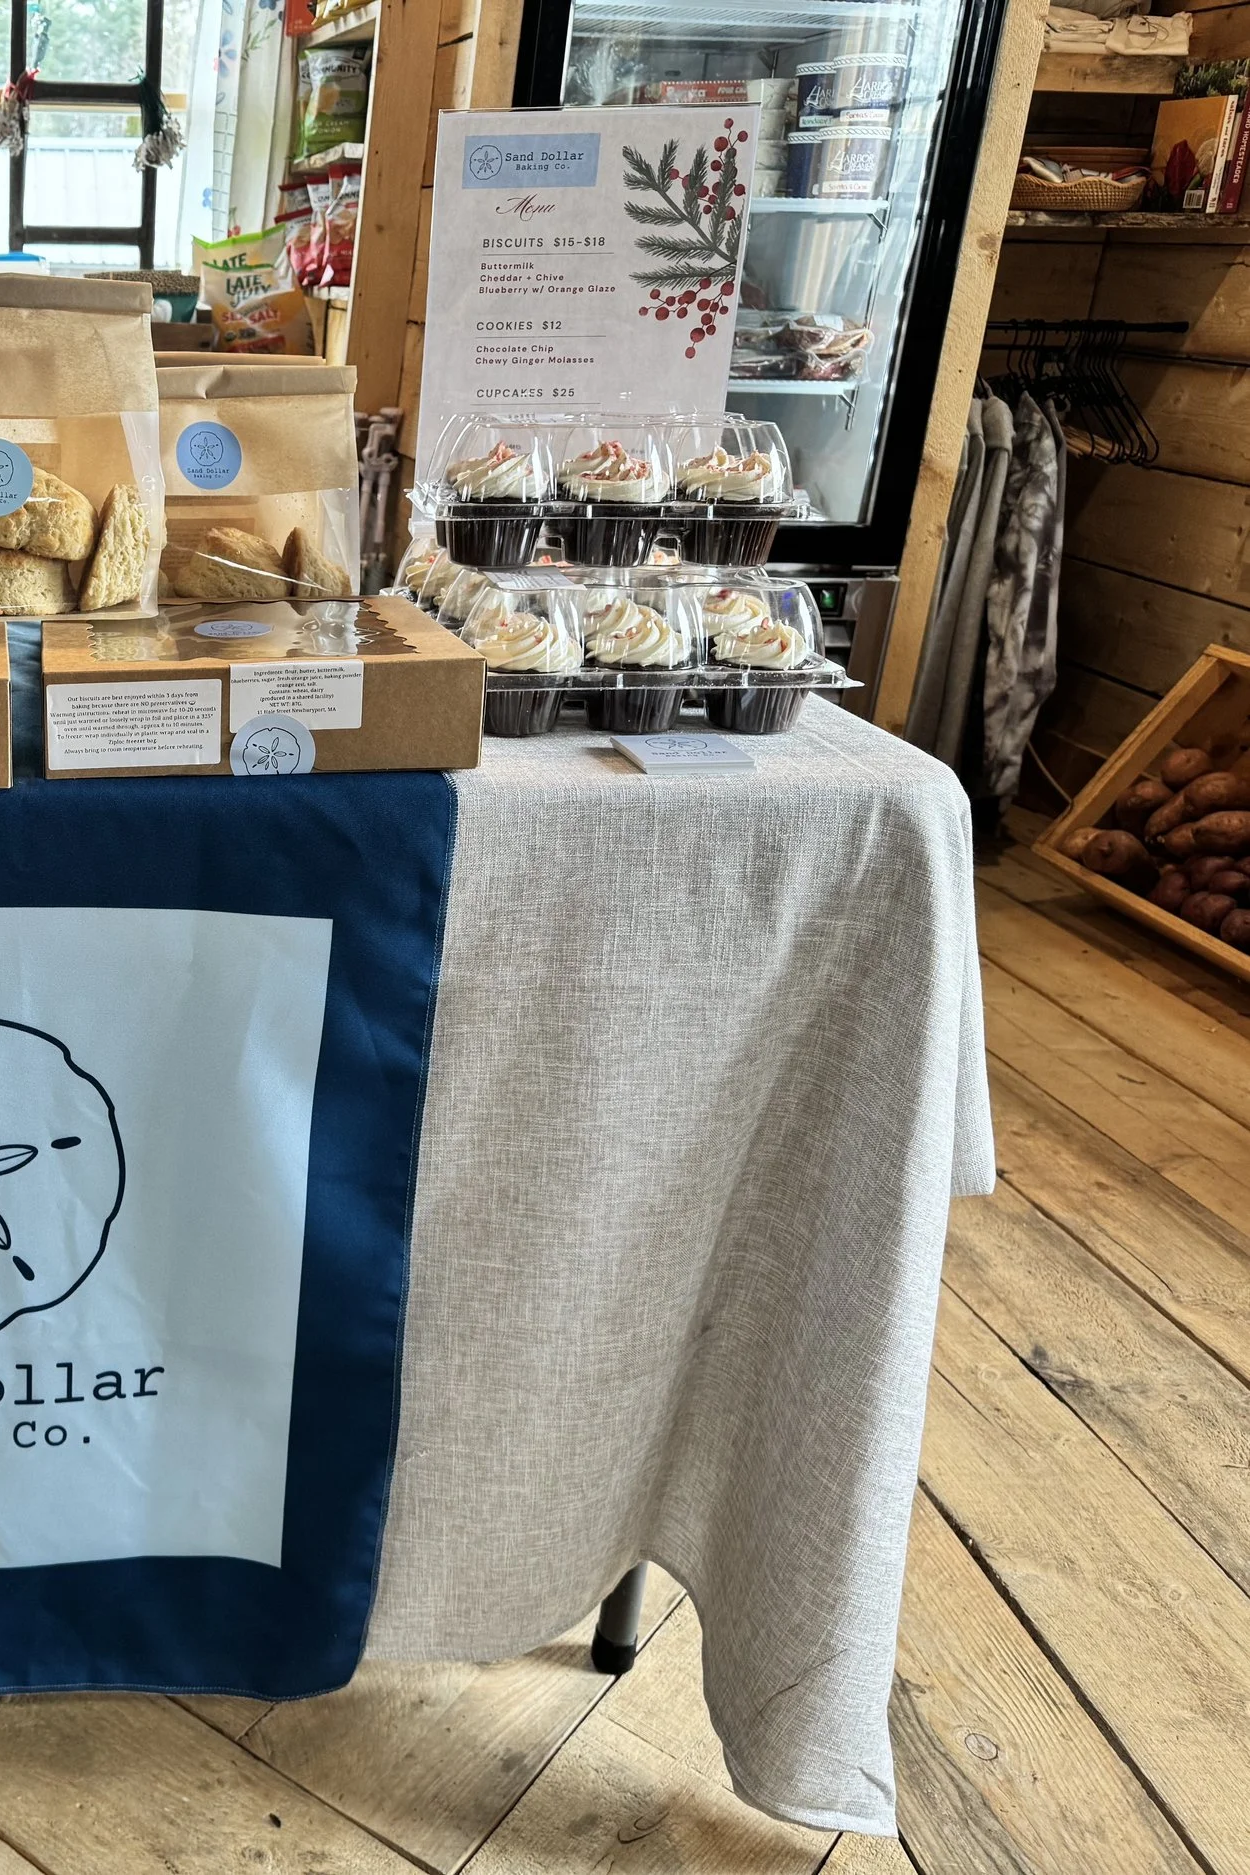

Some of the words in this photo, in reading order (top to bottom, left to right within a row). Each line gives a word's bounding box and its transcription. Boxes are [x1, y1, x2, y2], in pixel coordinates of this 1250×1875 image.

[505, 152, 534, 162] Sand
[541, 151, 584, 161] Dollar
[516, 163, 549, 171] Baking
[495, 193, 556, 222] Menu
[482, 238, 544, 248] BISCUITS
[481, 262, 534, 270] Buttermilk
[480, 274, 522, 282] Cheddar
[536, 273, 564, 281] Chive
[226, 275, 262, 296] LATE
[479, 286, 528, 295] Blueberry
[548, 286, 584, 295] Orange
[588, 285, 616, 293] Glaze
[249, 309, 279, 324] SALT
[476, 321, 533, 331] COOKIES
[542, 320, 562, 331] $12
[476, 345, 527, 353] Chocolate
[531, 344, 554, 354] Chip
[475, 357, 508, 366] Chewy
[512, 356, 544, 365] Ginger
[548, 356, 594, 364] Molasses
[476, 389, 543, 398] CUPCAKES
[552, 388, 575, 397] $25
[12, 1420, 92, 1449] Co.
